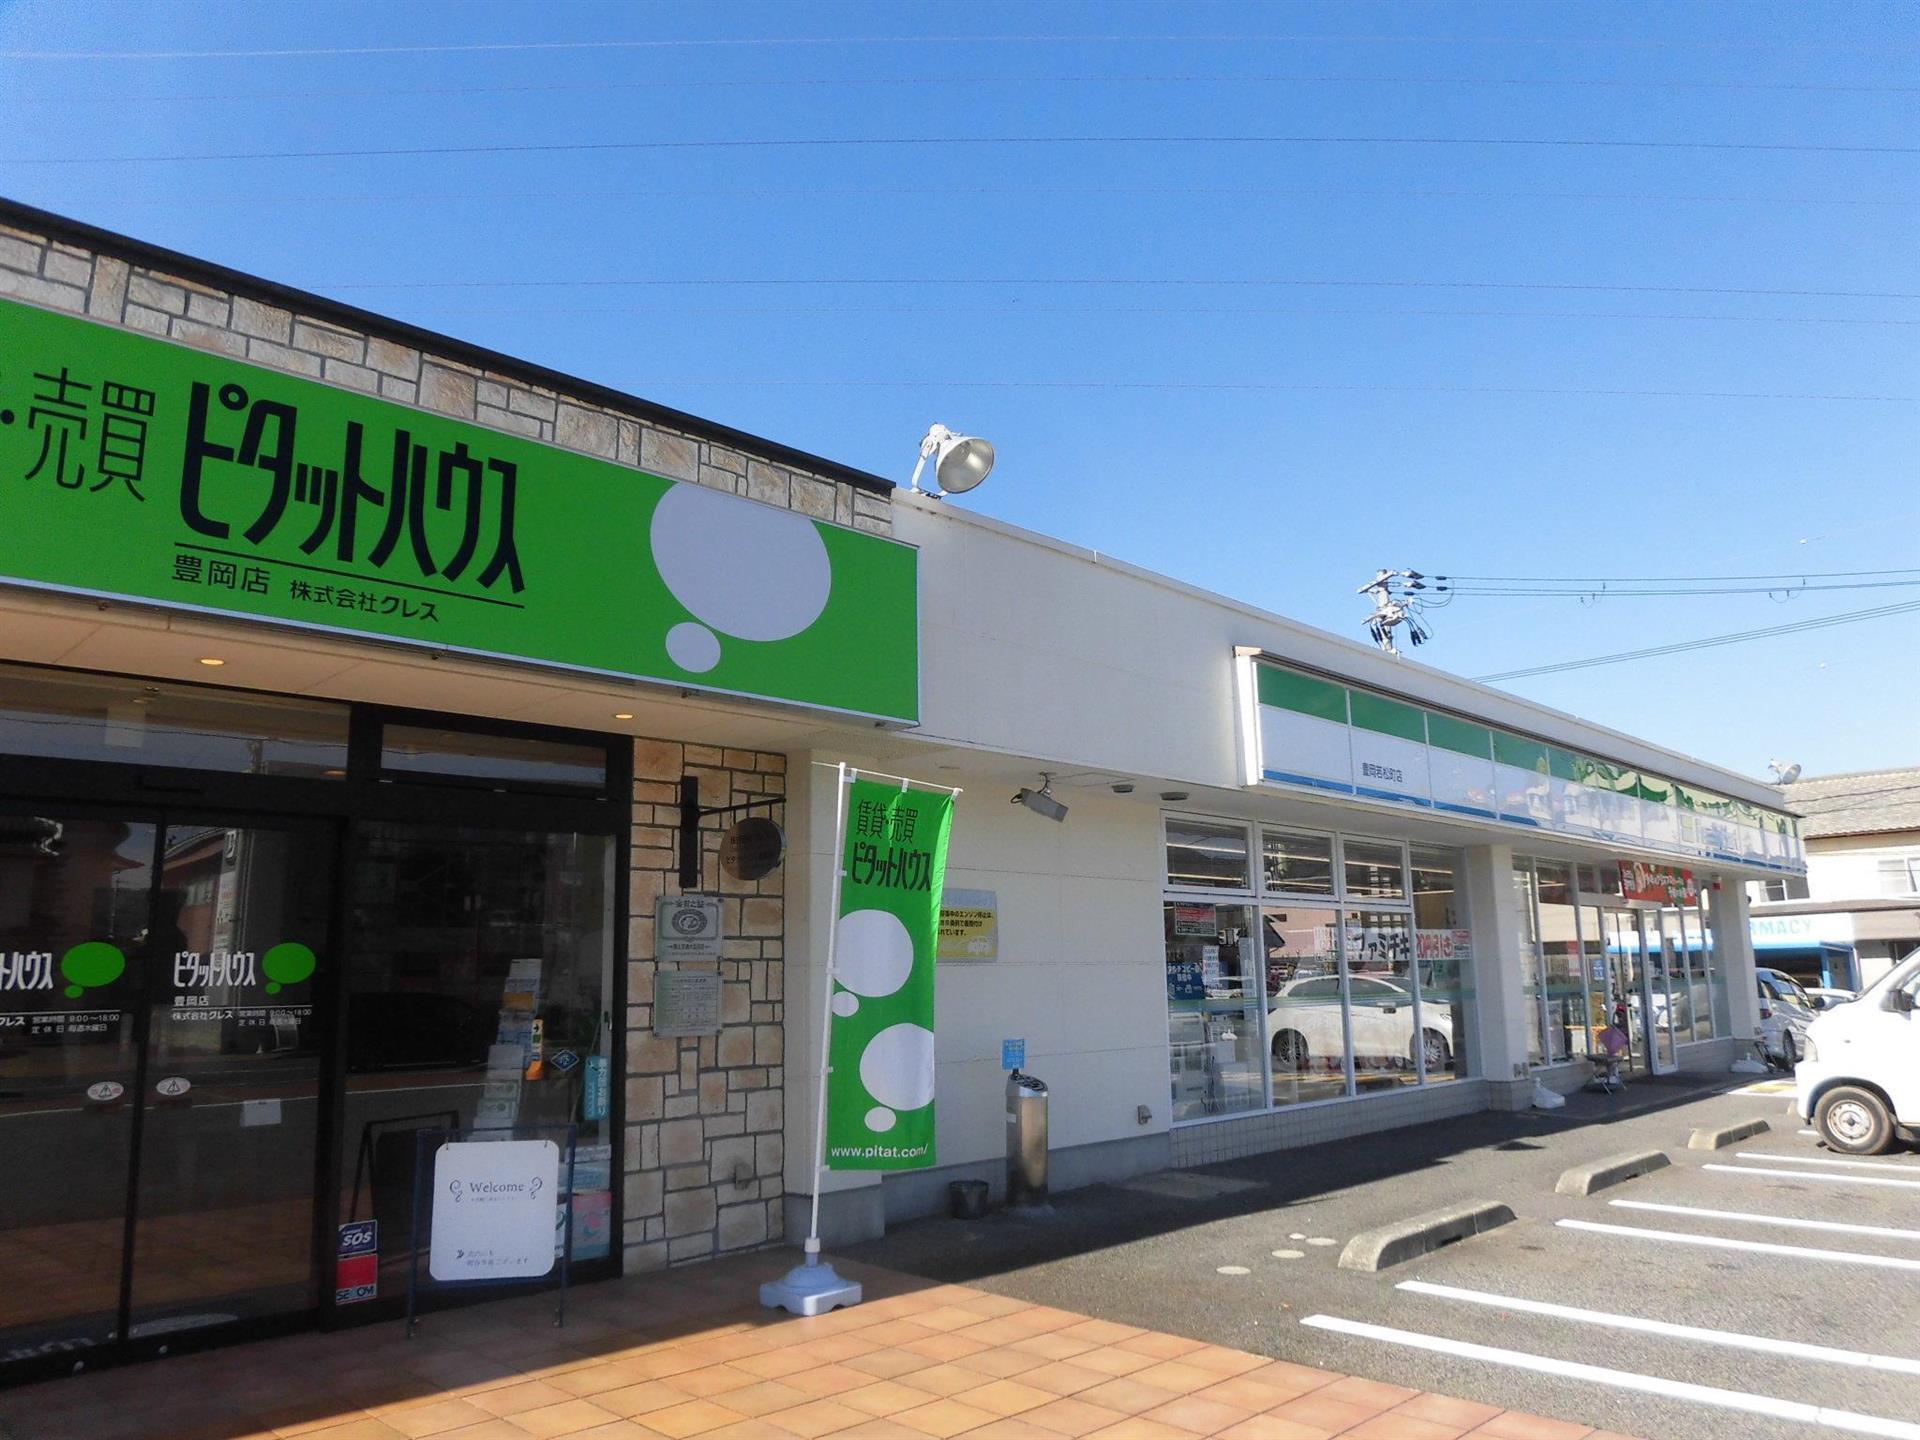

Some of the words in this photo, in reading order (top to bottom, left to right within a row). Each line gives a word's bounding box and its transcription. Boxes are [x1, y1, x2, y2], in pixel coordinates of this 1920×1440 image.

[180, 380, 525, 594] ピタットハウス
[172, 554, 271, 596] 豊岡店
[289, 579, 439, 623] 株式会社クレス
[856, 799, 919, 844] 賃貸・売買
[852, 841, 931, 892] ピタットハウス
[173, 951, 256, 988] ピタットハウス
[174, 995, 211, 1007] 豊岡店
[172, 1010, 234, 1021] 株式会社クレス
[830, 1143, 929, 1159] www.pitat.com/
[470, 1181, 525, 1193] Welcome
[342, 1231, 373, 1247] SOS
